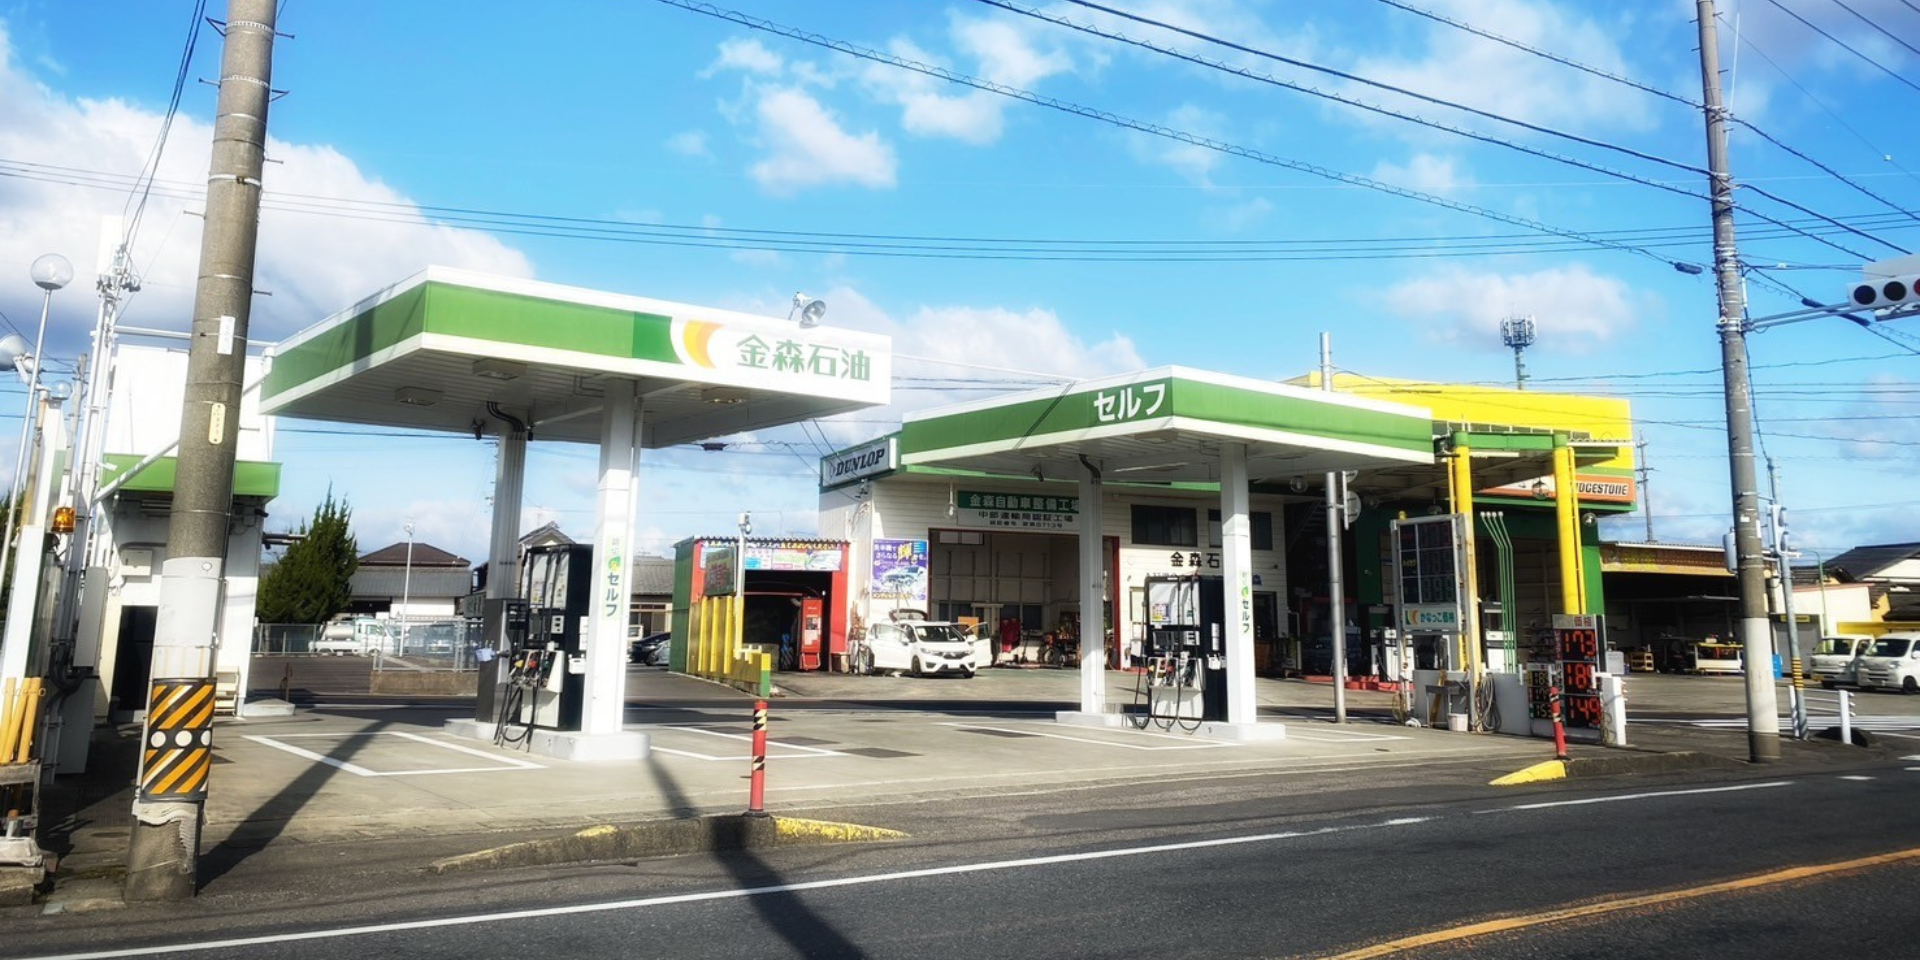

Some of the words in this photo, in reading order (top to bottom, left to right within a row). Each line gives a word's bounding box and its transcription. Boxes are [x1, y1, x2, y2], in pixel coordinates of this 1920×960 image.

[736, 334, 870, 381] 金森石油
[1093, 383, 1165, 422] セルフ
[836, 448, 885, 477] DUNLOP
[1576, 482, 1627, 495] IDGESTONE
[1170, 551, 1221, 568] 金森石
[606, 572, 620, 617] セルフ
[1242, 599, 1250, 633] セルフ
[1564, 630, 1596, 656] 173
